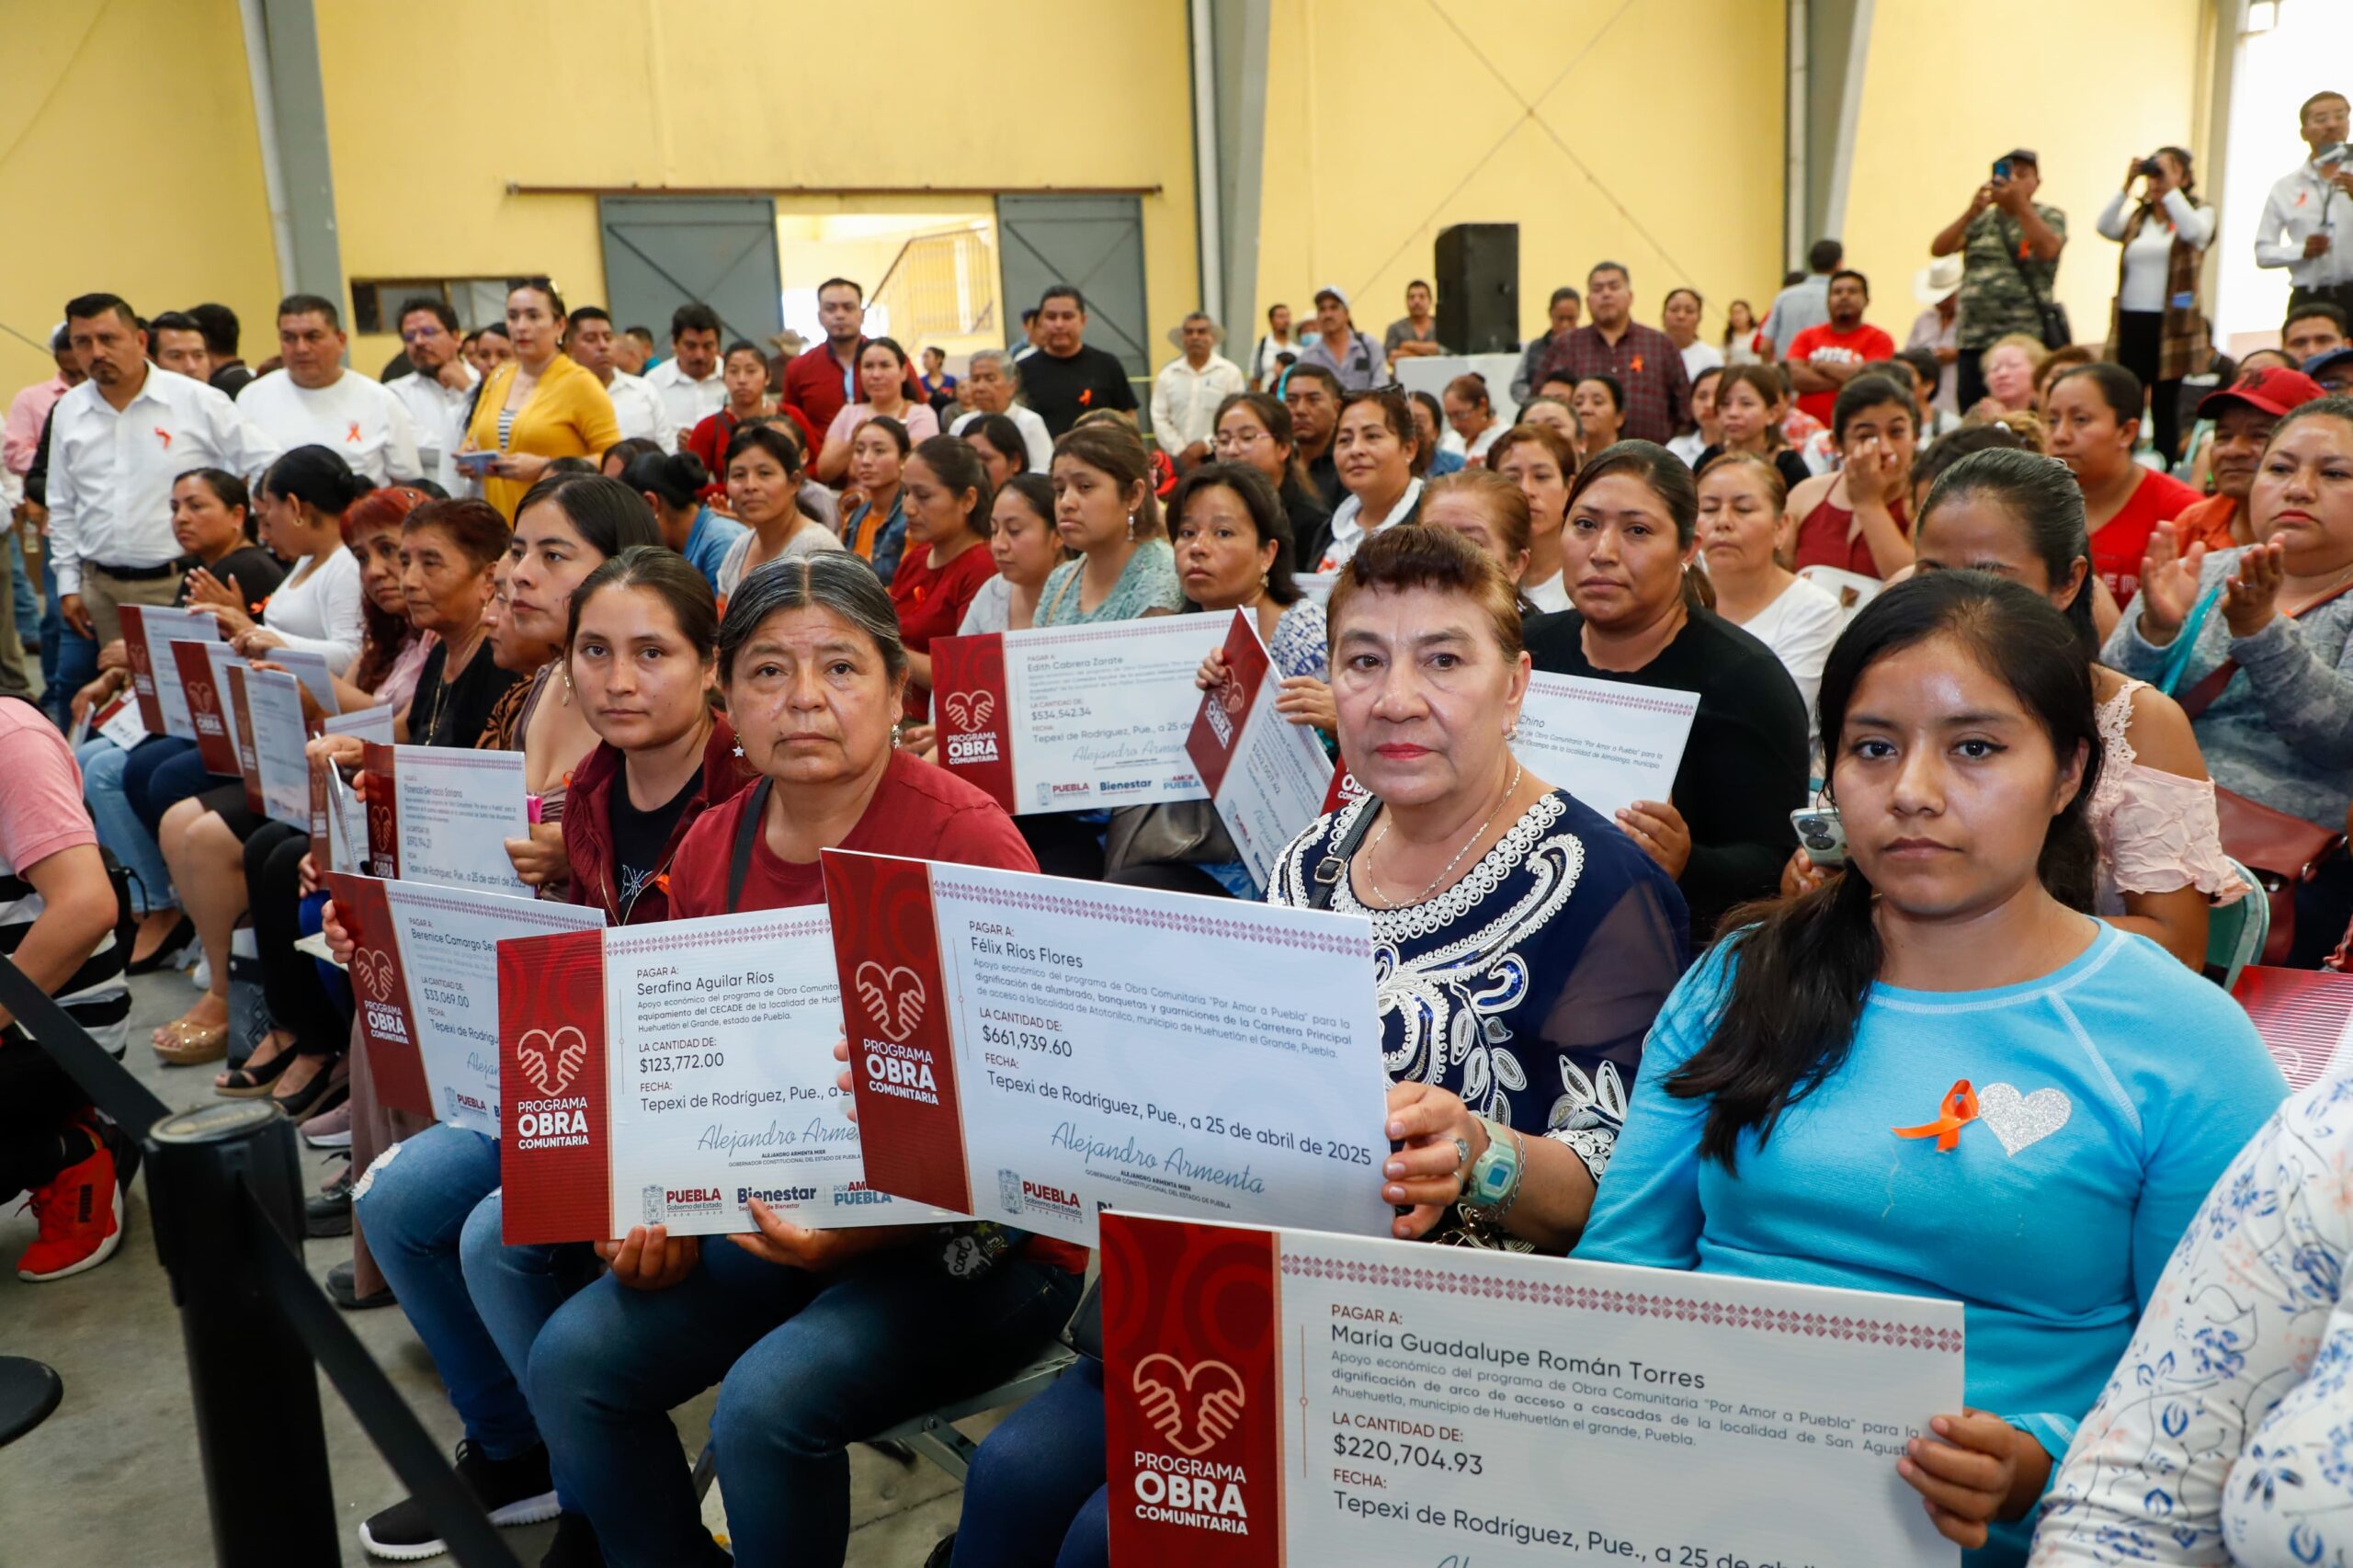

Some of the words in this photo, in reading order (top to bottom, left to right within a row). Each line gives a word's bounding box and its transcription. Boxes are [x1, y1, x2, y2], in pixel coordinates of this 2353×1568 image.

[1519, 715, 1544, 728] Chino
[948, 731, 997, 743] PROGRAMA
[1033, 734, 1064, 743] Tepexi
[948, 743, 997, 756] OBRA
[949, 756, 999, 765] COMUNITARIA
[1052, 783, 1089, 793] PUEBLA
[1100, 780, 1152, 791] Bienestar
[1164, 781, 1200, 790] PUEBLA
[412, 928, 443, 943] Berenice
[445, 934, 481, 950] Camargo
[970, 921, 1002, 934] PAGAR
[1006, 926, 1014, 937] A:
[972, 937, 1003, 955] Félix
[1040, 948, 1083, 968] Flores
[637, 967, 667, 978] PAGAR
[671, 967, 678, 975] A:
[638, 980, 691, 995] Serafina
[696, 974, 743, 992] Aguilar
[364, 1000, 403, 1016] PROGRAMA
[638, 1010, 691, 1021] equipamiento
[710, 1004, 743, 1014] CECADE
[769, 998, 805, 1008] localidad
[975, 972, 1028, 988] dignificación
[1031, 983, 1042, 991] de
[1045, 984, 1095, 1002] alumbrado,
[1151, 1005, 1155, 1013] y
[1223, 1016, 1236, 1025] de
[1240, 1017, 1249, 1027] la
[1253, 1019, 1302, 1037] Carretera
[1307, 1028, 1351, 1044] Principal
[980, 1007, 991, 1017] LA
[994, 1009, 1044, 1028] CANTIDAD
[1046, 1019, 1062, 1031] DE:
[368, 1012, 406, 1035] OBRA
[371, 1028, 409, 1044] COMUNITARIA
[640, 1043, 650, 1052] LA
[653, 1039, 699, 1051] CANTIDAD
[702, 1038, 716, 1047] DE:
[983, 1025, 1072, 1057] $661,939.60
[641, 1052, 723, 1074] $123,772.00
[863, 1039, 933, 1064] PROGRAMA
[985, 1053, 1018, 1069] FECHA:
[866, 1055, 937, 1091] OBRA
[641, 1082, 672, 1092] FECHA:
[870, 1081, 938, 1105] COMUNITARIA
[457, 1094, 486, 1110] PUEBLA
[518, 1096, 587, 1113] PROGRAMA
[642, 1096, 686, 1113] Tepexi
[690, 1095, 708, 1108] de
[790, 1086, 824, 1100] Pue.,
[829, 1086, 836, 1097] a
[518, 1110, 588, 1137] OBRA
[987, 1071, 1035, 1094] Tepexi
[1040, 1082, 1058, 1098] de
[1147, 1104, 1186, 1129] Pue.,
[1190, 1118, 1200, 1129] a
[1206, 1116, 1225, 1134] 25
[1230, 1122, 1252, 1140] de
[1256, 1129, 1294, 1149] abril
[1300, 1137, 1323, 1155] de
[1327, 1142, 1371, 1165] 2025
[518, 1135, 588, 1149] COMUNITARIA
[698, 1119, 796, 1156] Alejandro
[1051, 1121, 1157, 1164] Alejandro
[1165, 1147, 1265, 1194] Armenta
[666, 1188, 722, 1203] PUEBLA
[835, 1191, 892, 1206] PUEBLA
[1023, 1180, 1081, 1208] PUEBLA
[1332, 1304, 1384, 1322] PAGAR
[1389, 1312, 1402, 1324] A:
[1332, 1324, 1392, 1348] María
[1401, 1333, 1529, 1368] Guadalupe
[1539, 1350, 1620, 1378] Román
[1629, 1362, 1705, 1389] Torres
[1331, 1350, 1371, 1366] Apoyo
[1452, 1368, 1472, 1378] del
[1478, 1371, 1542, 1388] programa
[1549, 1380, 1566, 1392] de
[1572, 1381, 1607, 1397] Obra
[1612, 1387, 1699, 1409] Comunitaria
[1739, 1404, 1777, 1419] Amor
[1783, 1413, 1792, 1421] a
[1863, 1423, 1898, 1436] para
[1905, 1426, 1919, 1437] la
[1332, 1368, 1415, 1388] dignificación
[1424, 1381, 1441, 1392] de
[1449, 1386, 1480, 1397] arco
[1488, 1390, 1506, 1401] de
[1515, 1395, 1565, 1409] acceso
[1574, 1403, 1583, 1412] a
[1592, 1405, 1662, 1422] cascadas
[1671, 1414, 1688, 1426] de
[1699, 1417, 1711, 1428] la
[1721, 1419, 1787, 1439] localidad
[1796, 1432, 1815, 1443] de
[1825, 1435, 1853, 1449] San
[1862, 1439, 1909, 1457] Agust
[1332, 1385, 1405, 1406] Ahuehuetla,
[1410, 1398, 1470, 1414] municipio
[1473, 1405, 1490, 1416] de
[1573, 1419, 1584, 1429] el
[1588, 1423, 1641, 1439] grande,
[1645, 1428, 1696, 1446] Puebla.
[1333, 1412, 1350, 1426] LA
[1355, 1415, 1435, 1437] CANTIDAD
[1439, 1426, 1463, 1442] DE:
[1334, 1433, 1483, 1475] $220,704.93
[1134, 1451, 1246, 1484] PROGRAMA
[1334, 1469, 1386, 1489] FECHA:
[1134, 1471, 1247, 1518] OBRA
[1135, 1505, 1248, 1535] COMUNITARIA
[1334, 1491, 1408, 1520] Tepexi
[1416, 1506, 1446, 1526] de
[1454, 1509, 1579, 1551] Rodríguez,
[1588, 1531, 1646, 1562] Pue.,
[1655, 1548, 1671, 1562] a
[1679, 1546, 1708, 1568] 25
